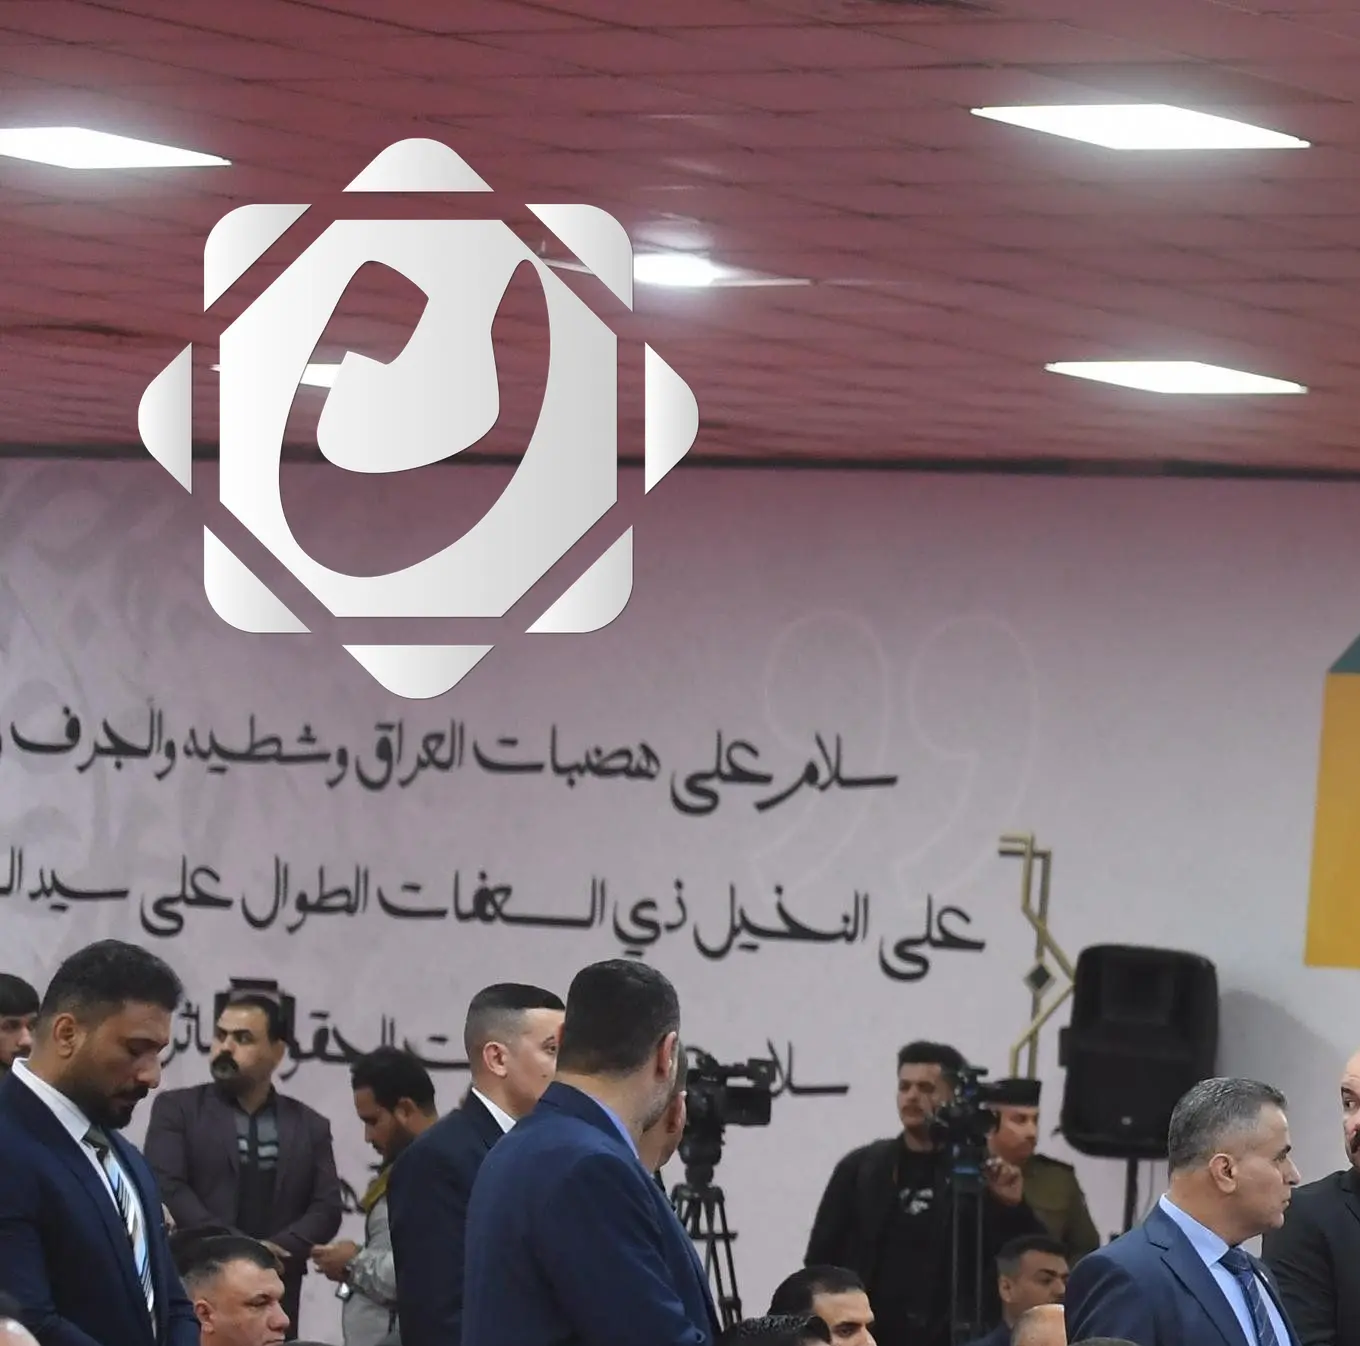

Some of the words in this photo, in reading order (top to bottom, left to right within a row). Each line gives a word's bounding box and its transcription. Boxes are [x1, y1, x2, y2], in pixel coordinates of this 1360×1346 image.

[9, 704, 177, 782] والجرف
[354, 719, 465, 792] العراق
[472, 724, 661, 789] هضبات
[669, 729, 774, 818] على
[753, 732, 899, 814] سلام
[27, 866, 131, 914] سيد
[139, 854, 234, 939] على
[240, 854, 370, 936] الطوال
[376, 869, 606, 931] السعفات
[612, 877, 688, 957] ذي
[692, 883, 870, 962] النخيل
[878, 893, 987, 984] على
[765, 1036, 850, 1099] سلا
